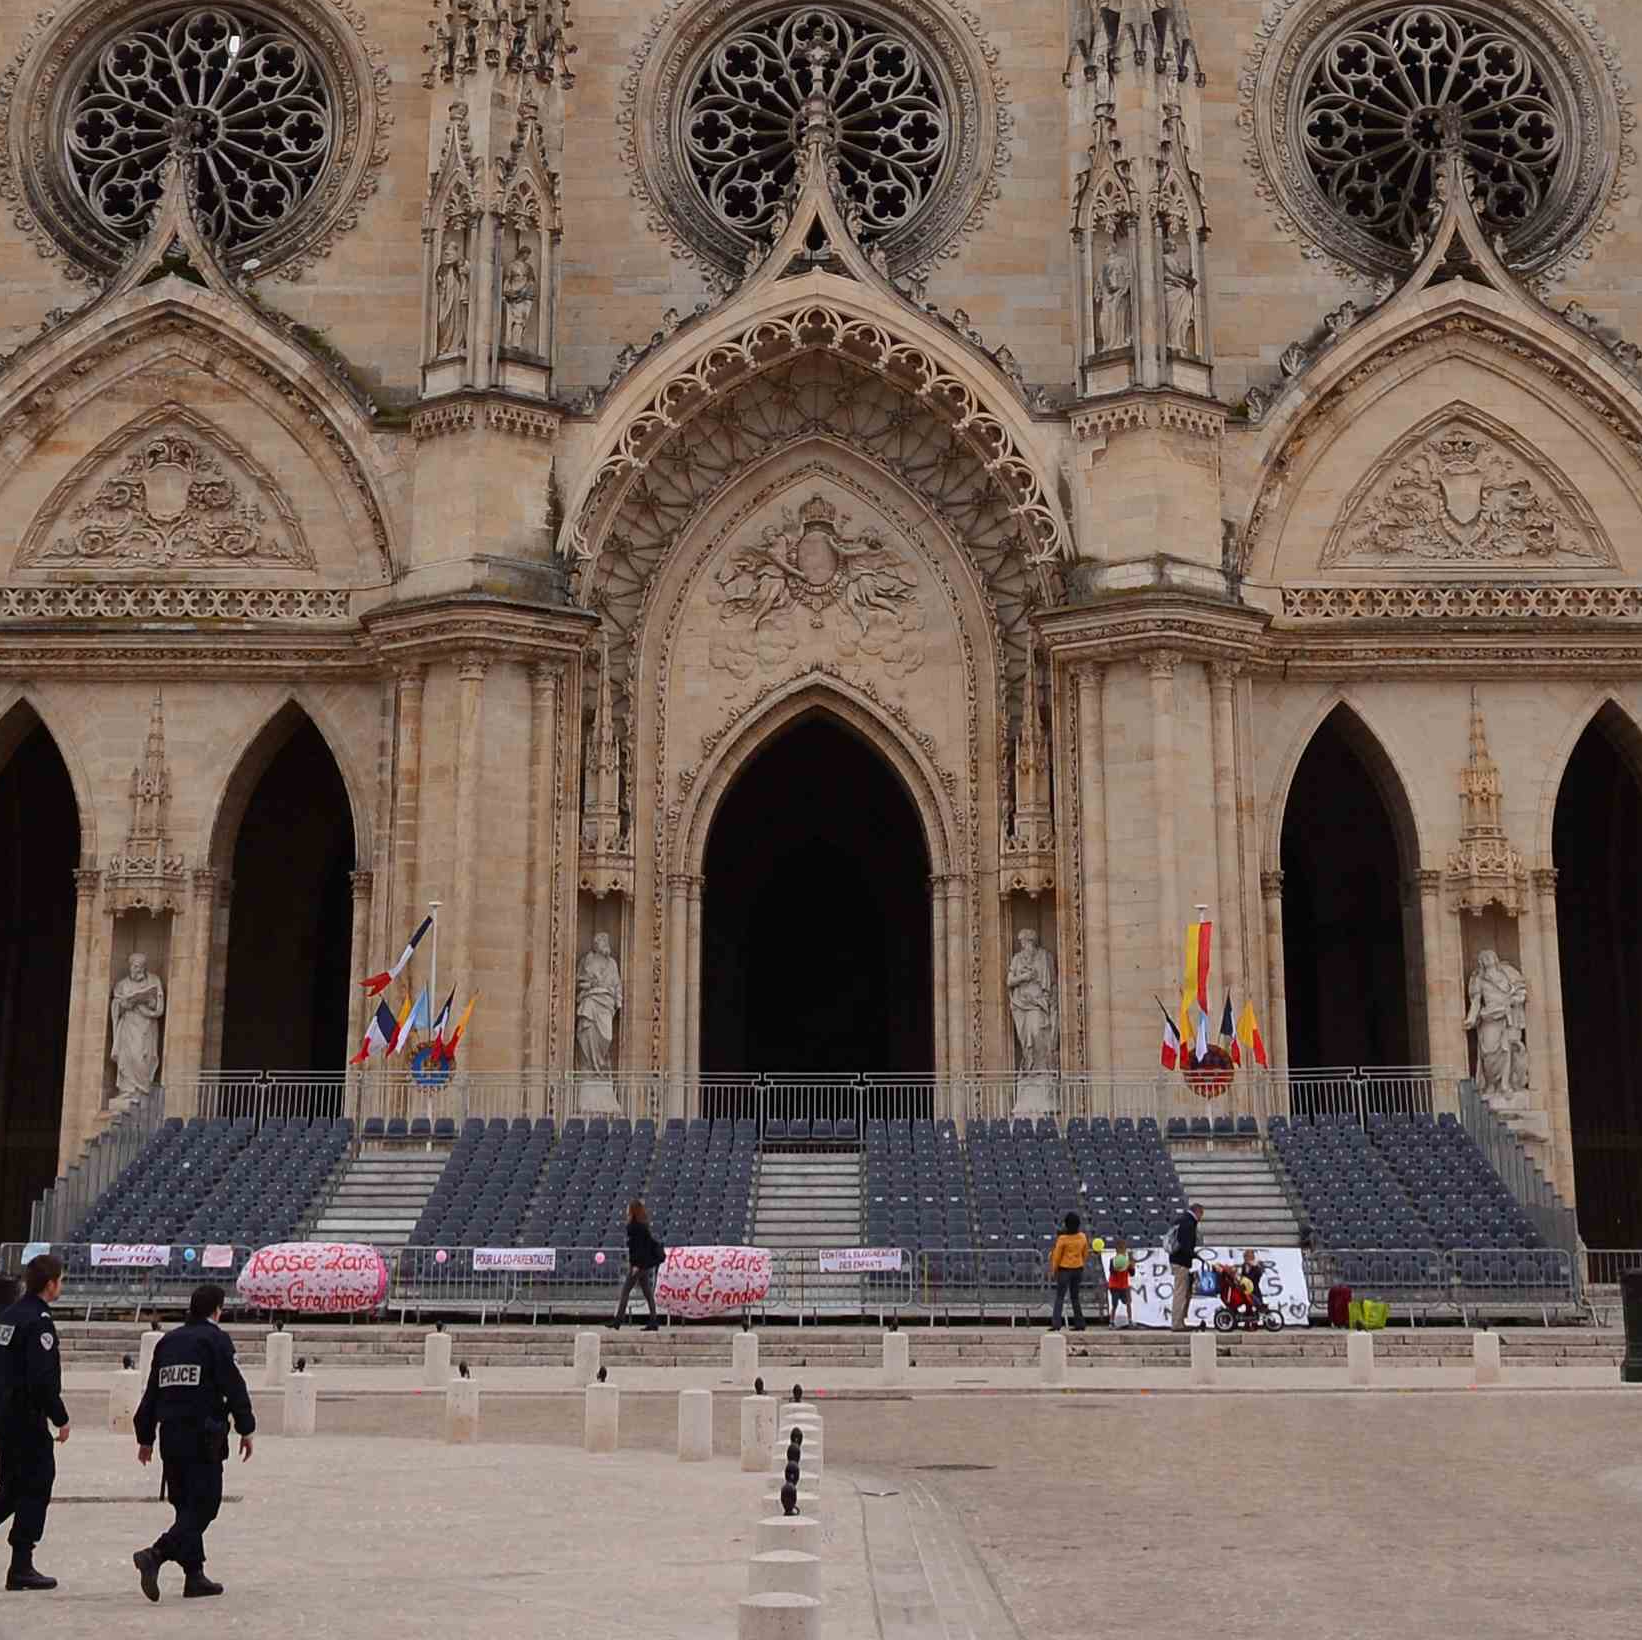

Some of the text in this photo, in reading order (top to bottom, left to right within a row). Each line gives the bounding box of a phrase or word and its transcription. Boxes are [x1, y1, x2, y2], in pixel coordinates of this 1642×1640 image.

[251, 1248, 318, 1279] Rose
[664, 1246, 709, 1271] Rose
[160, 1367, 197, 1385] POLICE
